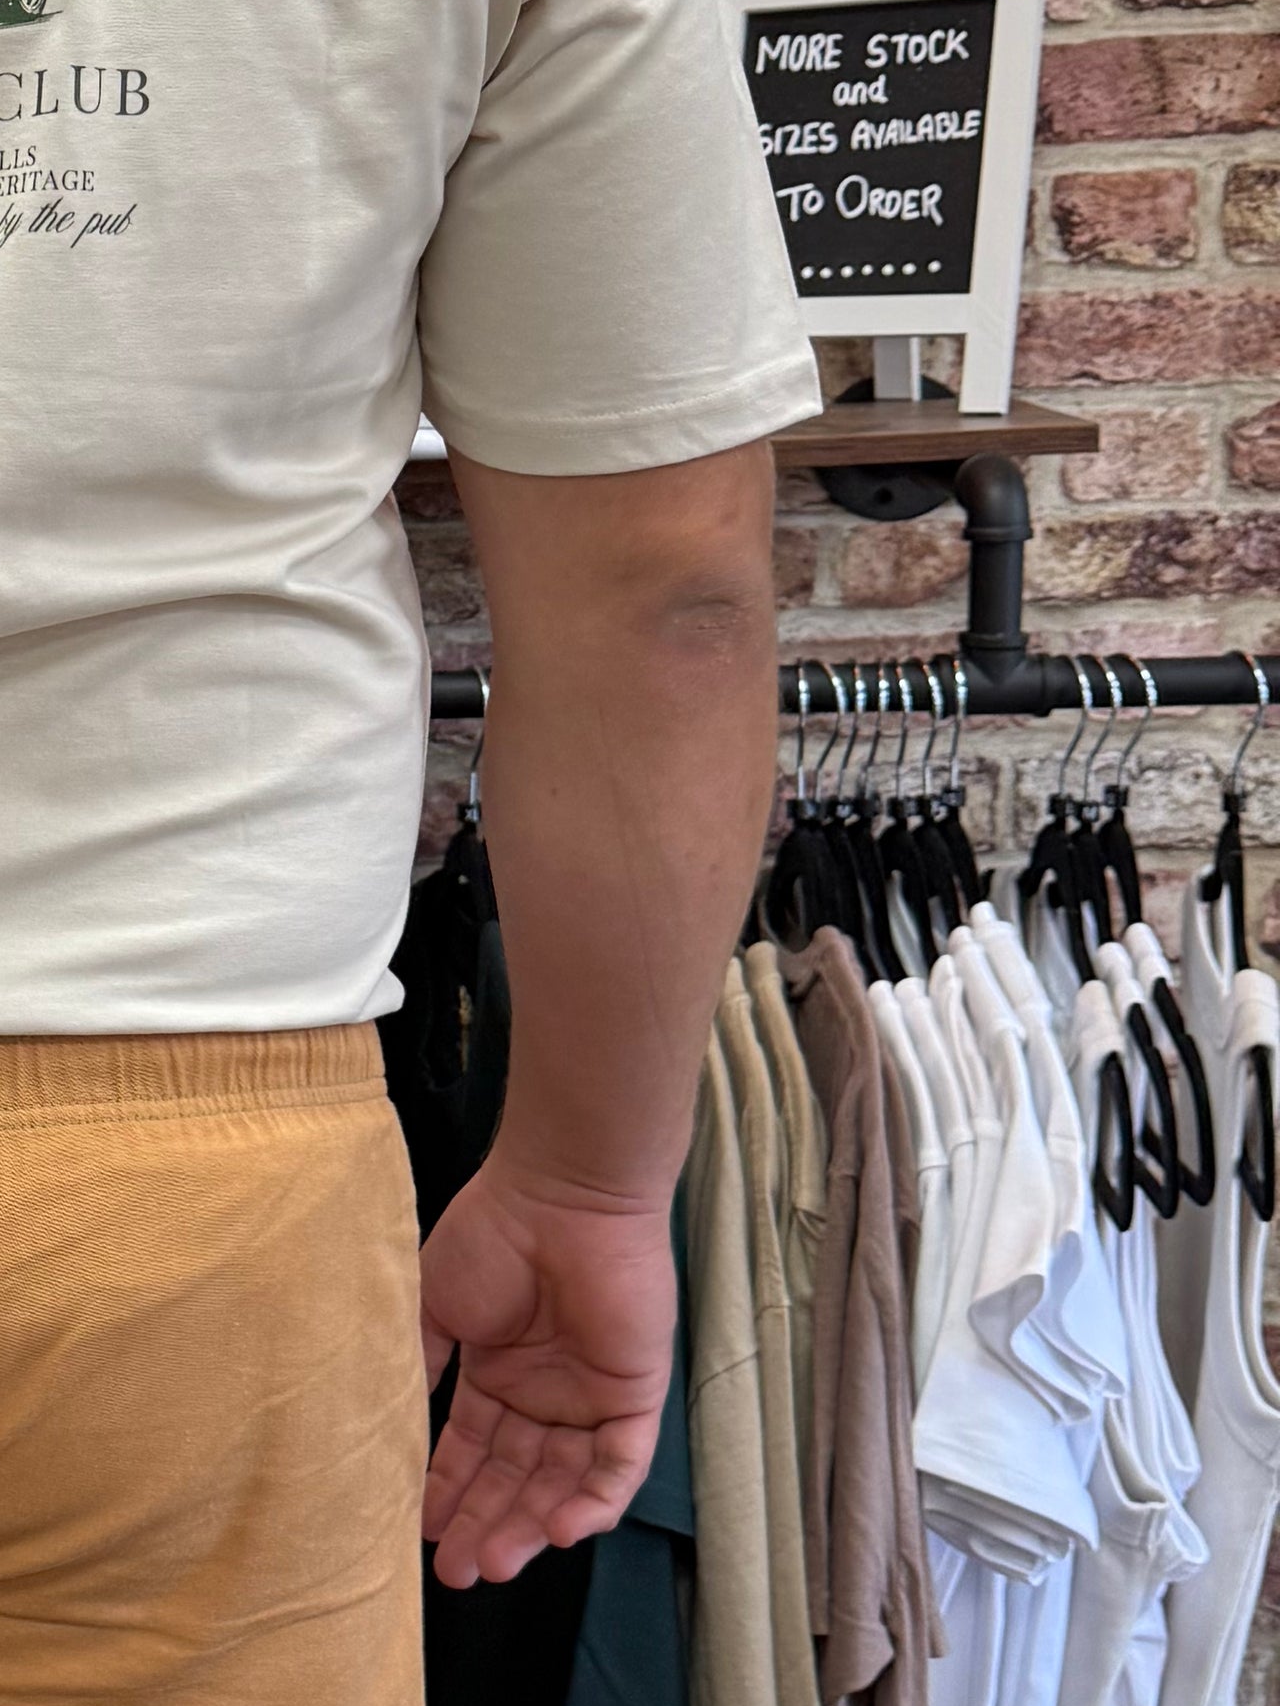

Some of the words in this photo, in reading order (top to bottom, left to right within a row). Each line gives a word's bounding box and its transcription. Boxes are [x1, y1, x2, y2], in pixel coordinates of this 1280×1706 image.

[755, 32, 843, 75] MORE
[864, 28, 970, 69] STOCK
[832, 74, 889, 107] and
[757, 121, 839, 157] SIZES
[850, 109, 983, 151] AVAILABLE
[28, 196, 75, 234] the
[69, 203, 138, 250] pub
